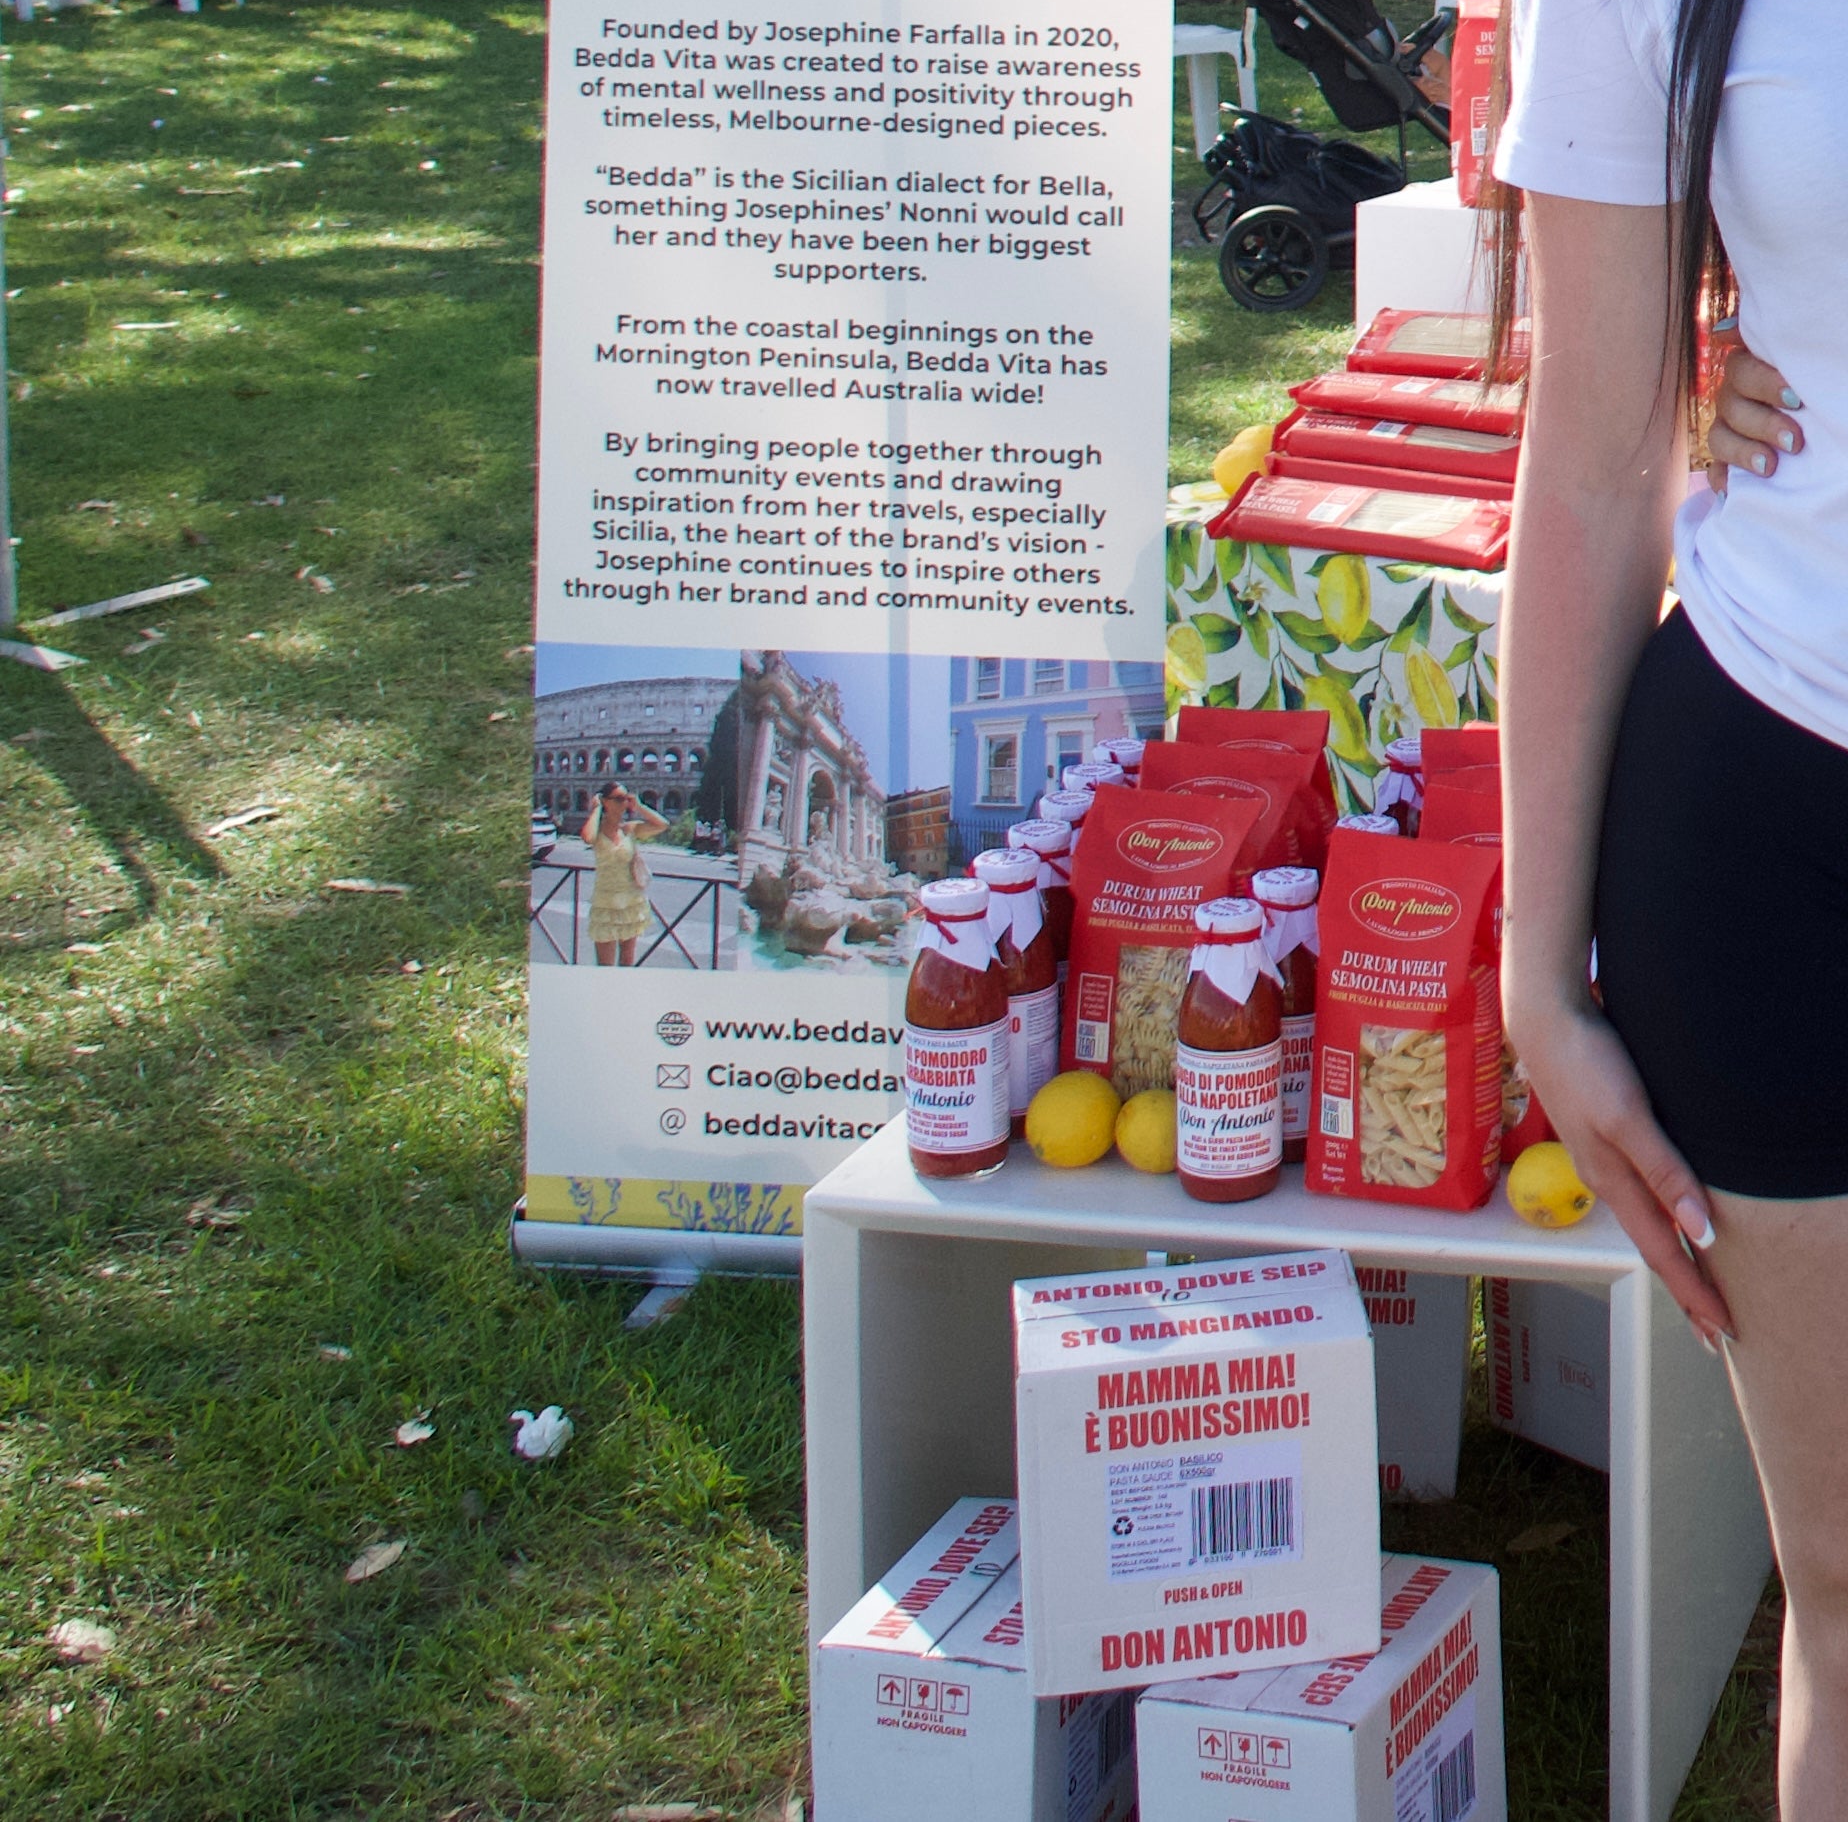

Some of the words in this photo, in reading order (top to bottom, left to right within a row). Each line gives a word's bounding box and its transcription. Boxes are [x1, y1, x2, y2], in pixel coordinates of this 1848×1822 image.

[600, 18, 719, 41] Founded
[725, 18, 759, 48] by
[763, 20, 902, 49] Josephine
[908, 22, 1006, 47] Farfalla
[1013, 23, 1039, 47] in
[1046, 25, 1120, 52] 2020,
[573, 46, 656, 70] Bedda
[661, 46, 718, 71] Vita
[723, 53, 776, 72] was
[780, 51, 884, 74] created
[889, 54, 920, 75] to
[925, 52, 990, 77] raise
[995, 59, 1142, 79] awareness
[578, 75, 606, 98] of
[609, 77, 705, 100] mental
[711, 78, 827, 103] wellness
[832, 80, 885, 104] and
[891, 81, 1016, 112] positivity
[1021, 84, 1134, 114] through
[600, 104, 722, 134] timeless,
[727, 108, 1005, 141] Melbourne-designed
[1011, 113, 1108, 142] pieces.
[593, 164, 707, 188] “Bedda”
[713, 165, 735, 190] is
[739, 167, 785, 191] the
[790, 167, 888, 193] Sicilian
[893, 170, 986, 196] dialect
[991, 172, 1031, 196] for
[1038, 174, 1114, 201] Bella,
[583, 194, 728, 224] something
[733, 197, 892, 226] Josephines’
[897, 200, 978, 225] Nonni
[983, 203, 1069, 227] would
[1076, 204, 1124, 228] call
[612, 223, 659, 247] her
[664, 225, 717, 249] and
[722, 225, 783, 255] they
[788, 227, 855, 252] have
[860, 229, 929, 254] been
[935, 230, 981, 255] her
[986, 232, 1092, 262] biggest
[772, 261, 928, 286] supporters.
[614, 313, 687, 336] From
[692, 314, 739, 337] the
[743, 317, 839, 340] coastal
[846, 317, 999, 350] beginnings
[1003, 327, 1040, 346] on
[1046, 323, 1094, 347] the
[593, 341, 751, 372] Mornington
[757, 346, 899, 375] Peninsula,
[903, 350, 990, 375] Bedda
[996, 350, 1052, 376] Vita
[1059, 352, 1109, 377] has
[654, 377, 715, 396] now
[718, 375, 837, 400] travelled
[843, 378, 963, 404] Australia
[969, 380, 1044, 406] wide!
[603, 431, 639, 459] By
[644, 430, 760, 462] bringing
[765, 436, 860, 464] people
[865, 438, 985, 468] together
[989, 441, 1103, 472] through
[632, 462, 788, 493] community
[793, 468, 886, 490] events
[888, 468, 943, 494] and
[949, 469, 1063, 501] drawing
[591, 488, 735, 518] inspiration
[739, 492, 808, 518] from
[814, 494, 862, 519] her
[866, 495, 965, 526] travels,
[970, 501, 1107, 532] especially
[591, 517, 677, 548] Sicilia,
[681, 520, 729, 545] the
[733, 522, 807, 547] heart
[812, 524, 843, 548] of
[848, 527, 894, 551] the
[902, 528, 1002, 553] brand’s
[1007, 532, 1088, 557] vision
[594, 549, 732, 577] Josephine
[736, 553, 873, 579] continues
[879, 555, 909, 583] to
[914, 556, 1006, 587] inspire
[1011, 561, 1102, 586] others
[561, 576, 670, 607] through
[676, 579, 723, 604] her
[727, 581, 808, 607] brand
[815, 585, 868, 609] and
[874, 588, 1030, 619] community
[1035, 594, 1135, 617] events.
[1361, 891, 1396, 913] Don
[1393, 898, 1453, 926] Antonio
[1341, 950, 1398, 974] DURUM
[1401, 959, 1448, 978] WHEAT
[1330, 969, 1405, 996] SEMOLINA
[1408, 980, 1448, 999] PASTA
[1180, 1105, 1206, 1129] Don
[1210, 1106, 1275, 1136] Antonio
[1032, 1280, 1172, 1304] ANTONIO,
[1178, 1270, 1256, 1291] DOVE
[1261, 1261, 1327, 1282] SEI?
[1061, 1327, 1122, 1349] STO
[1129, 1304, 1323, 1340] MANGIANDO.
[1097, 1361, 1222, 1410] MAMMA
[1228, 1352, 1296, 1394] MIA!
[1085, 1410, 1101, 1454] È
[1108, 1392, 1311, 1450] BUONISSIMO!
[1164, 1586, 1198, 1605] PUSH
[1200, 1586, 1209, 1600] &
[1211, 1580, 1243, 1597] OPEN
[1102, 1628, 1165, 1672] DON
[1173, 1609, 1307, 1662] ANTONIO
[877, 1716, 900, 1728] NON
[901, 1709, 945, 1723] FRAGILE
